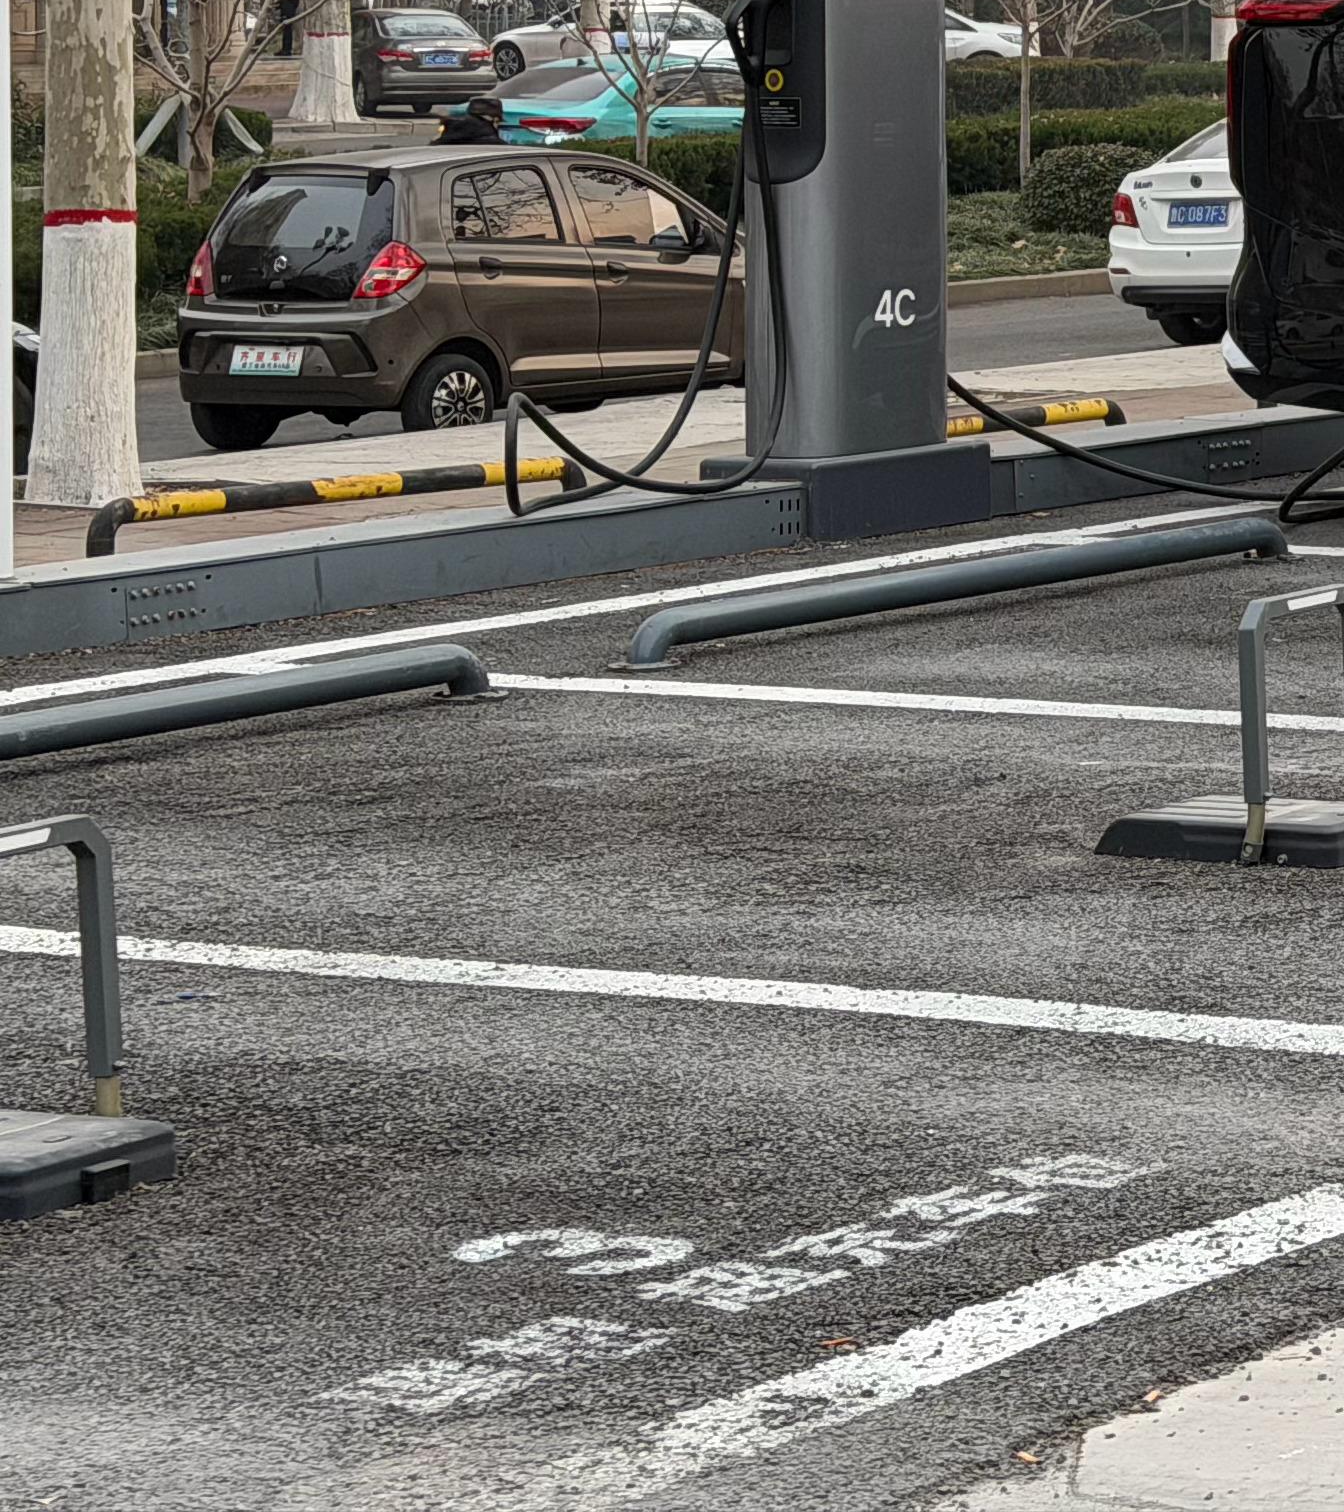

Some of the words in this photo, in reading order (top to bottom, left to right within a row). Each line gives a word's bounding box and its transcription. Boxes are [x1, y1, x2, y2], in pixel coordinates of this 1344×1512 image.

[874, 288, 916, 328] 4C
[452, 1226, 694, 1275] 3
[636, 1154, 1165, 1311] 超充车位
